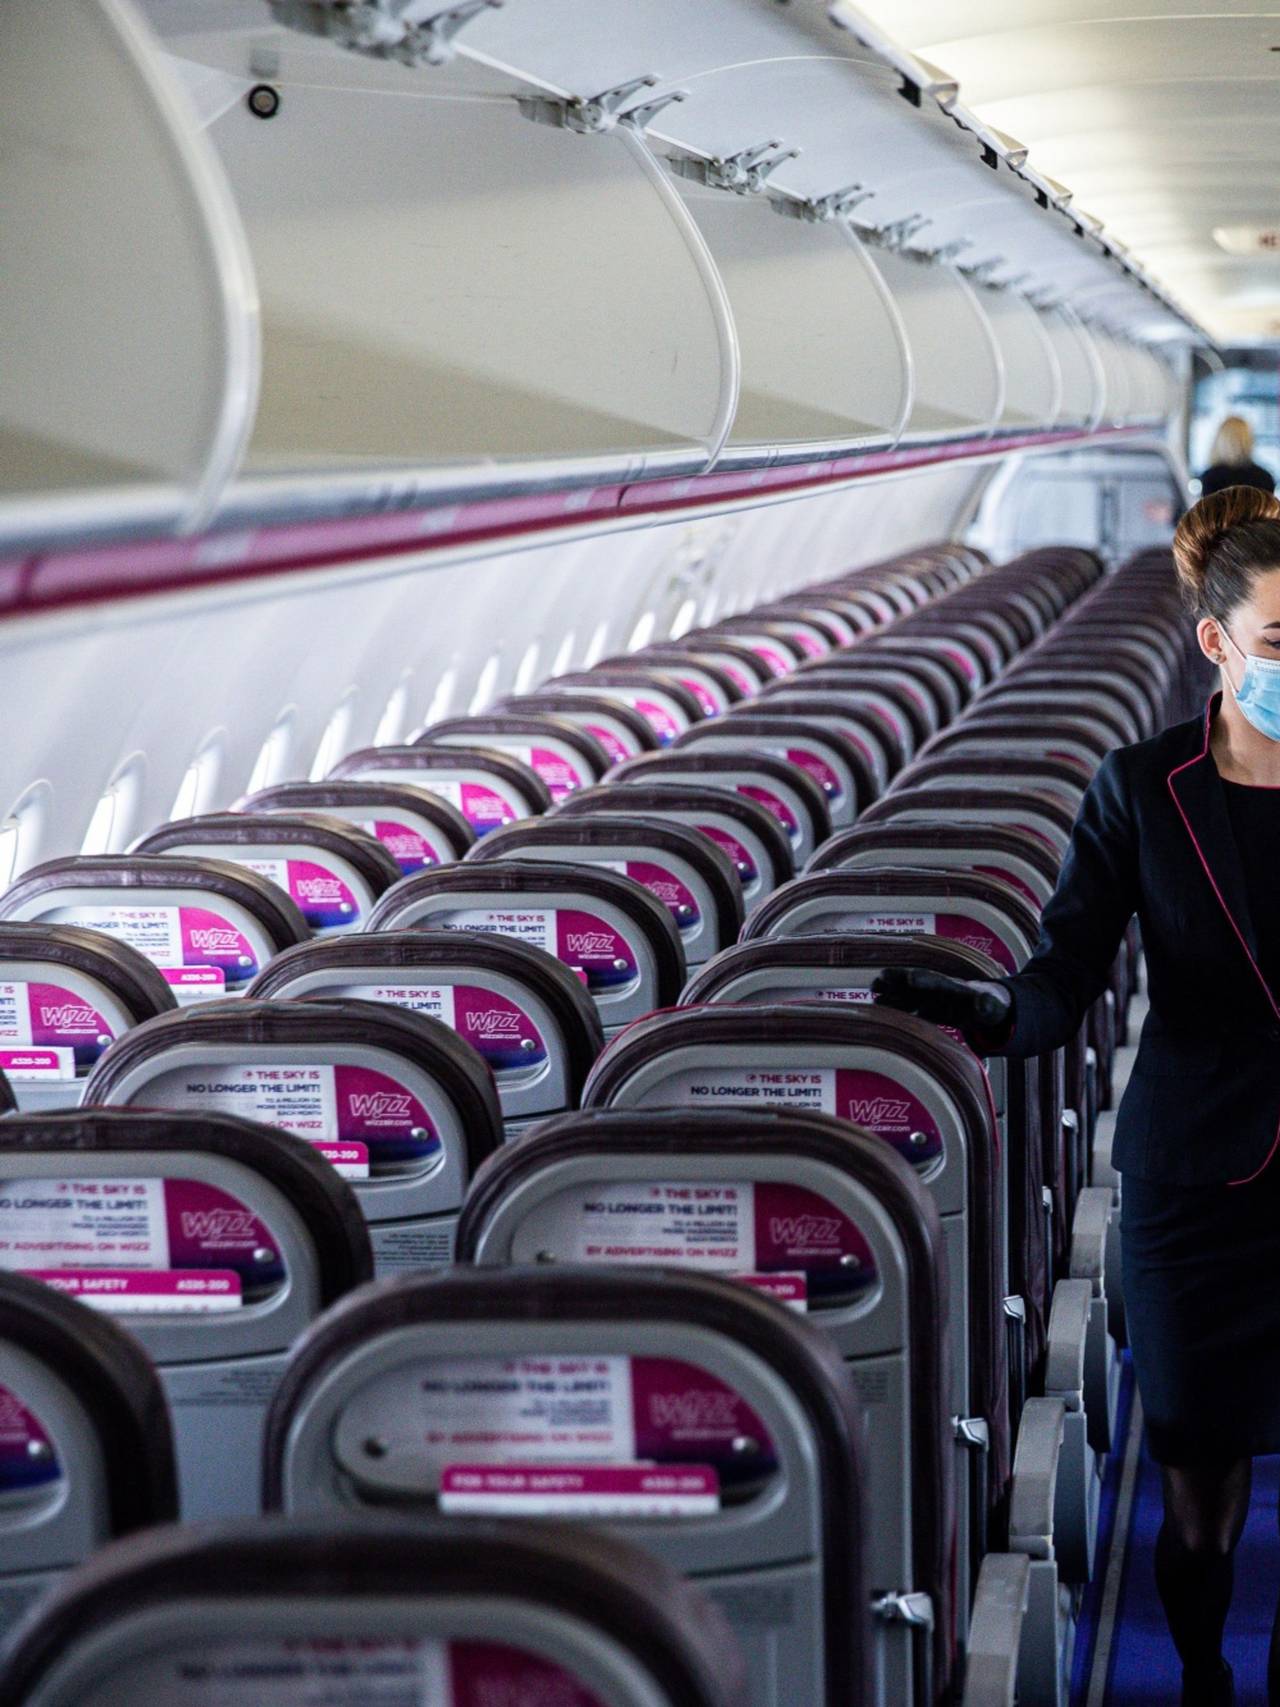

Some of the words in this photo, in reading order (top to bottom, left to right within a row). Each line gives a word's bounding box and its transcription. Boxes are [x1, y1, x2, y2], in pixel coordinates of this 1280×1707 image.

[877, 918, 894, 926] THE
[896, 918, 914, 926] SKY
[916, 918, 925, 926] IS
[387, 990, 406, 998] THE
[409, 990, 428, 998] SKY
[431, 990, 440, 998] IS
[827, 992, 846, 1000] THE
[848, 992, 867, 1000] SKY
[412, 1002, 441, 1010] LIMIT!
[257, 1071, 280, 1079] THE
[283, 1071, 306, 1079] SKY
[309, 1071, 320, 1079] IS
[760, 1075, 783, 1084] THE
[785, 1075, 808, 1084] SKY
[811, 1075, 821, 1084] IS
[187, 1084, 205, 1093] NO
[208, 1084, 257, 1093] LONGER
[260, 1084, 284, 1093] THE
[286, 1084, 321, 1093] LIMIT!
[691, 1087, 709, 1097] NO
[712, 1087, 760, 1097] LONGER
[763, 1087, 785, 1097] THE
[788, 1087, 821, 1097] LIMIT!
[278, 1121, 297, 1129] ON
[299, 1121, 322, 1129] WIZZ
[72, 1184, 98, 1194] THE
[103, 1184, 130, 1194] SKY
[133, 1184, 146, 1194] IS
[665, 1189, 690, 1199] THE
[694, 1189, 720, 1199] SKY
[725, 1189, 737, 1199] IS
[78, 1200, 106, 1209] THE
[609, 1203, 664, 1214] LONGER
[668, 1203, 694, 1214] THE
